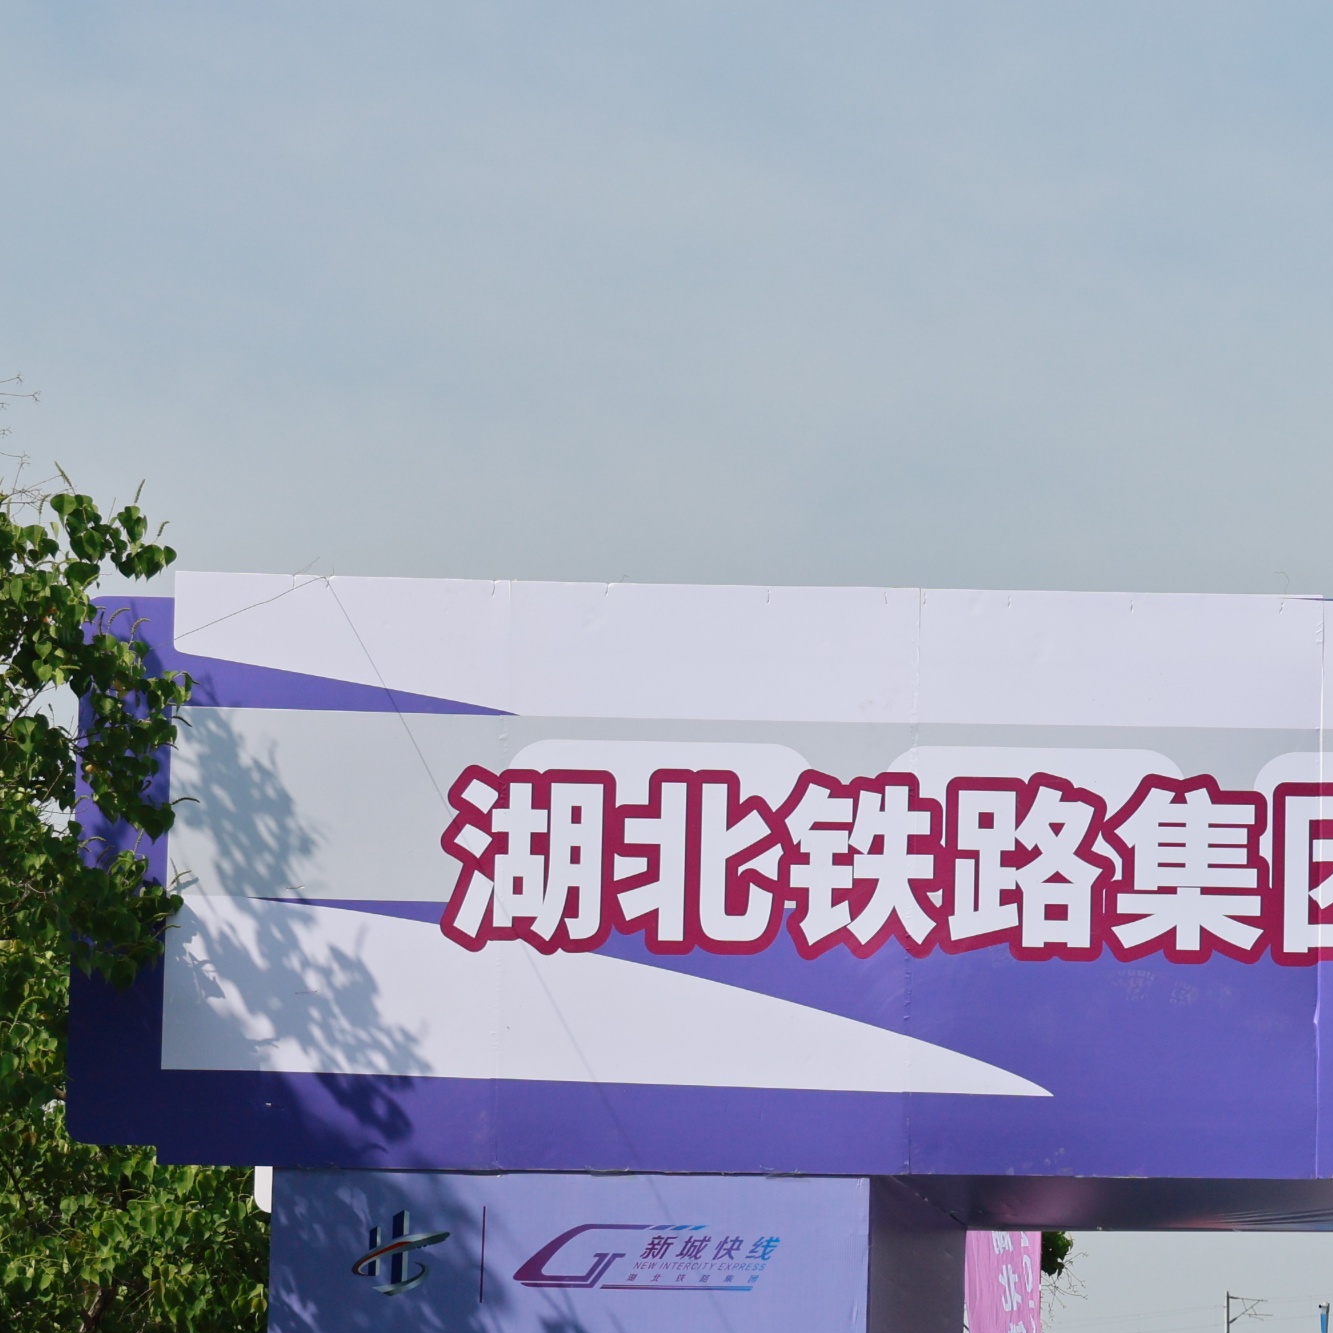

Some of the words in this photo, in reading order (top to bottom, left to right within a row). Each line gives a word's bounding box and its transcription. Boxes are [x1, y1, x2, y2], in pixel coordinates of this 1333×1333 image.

[640, 1235, 780, 1261] 新城快线
[633, 1262, 657, 1270] NEW
[659, 1262, 716, 1271] INTERCITY
[718, 1263, 767, 1271] EXPRESS
[626, 1274, 759, 1283] 湖北铁路集团
